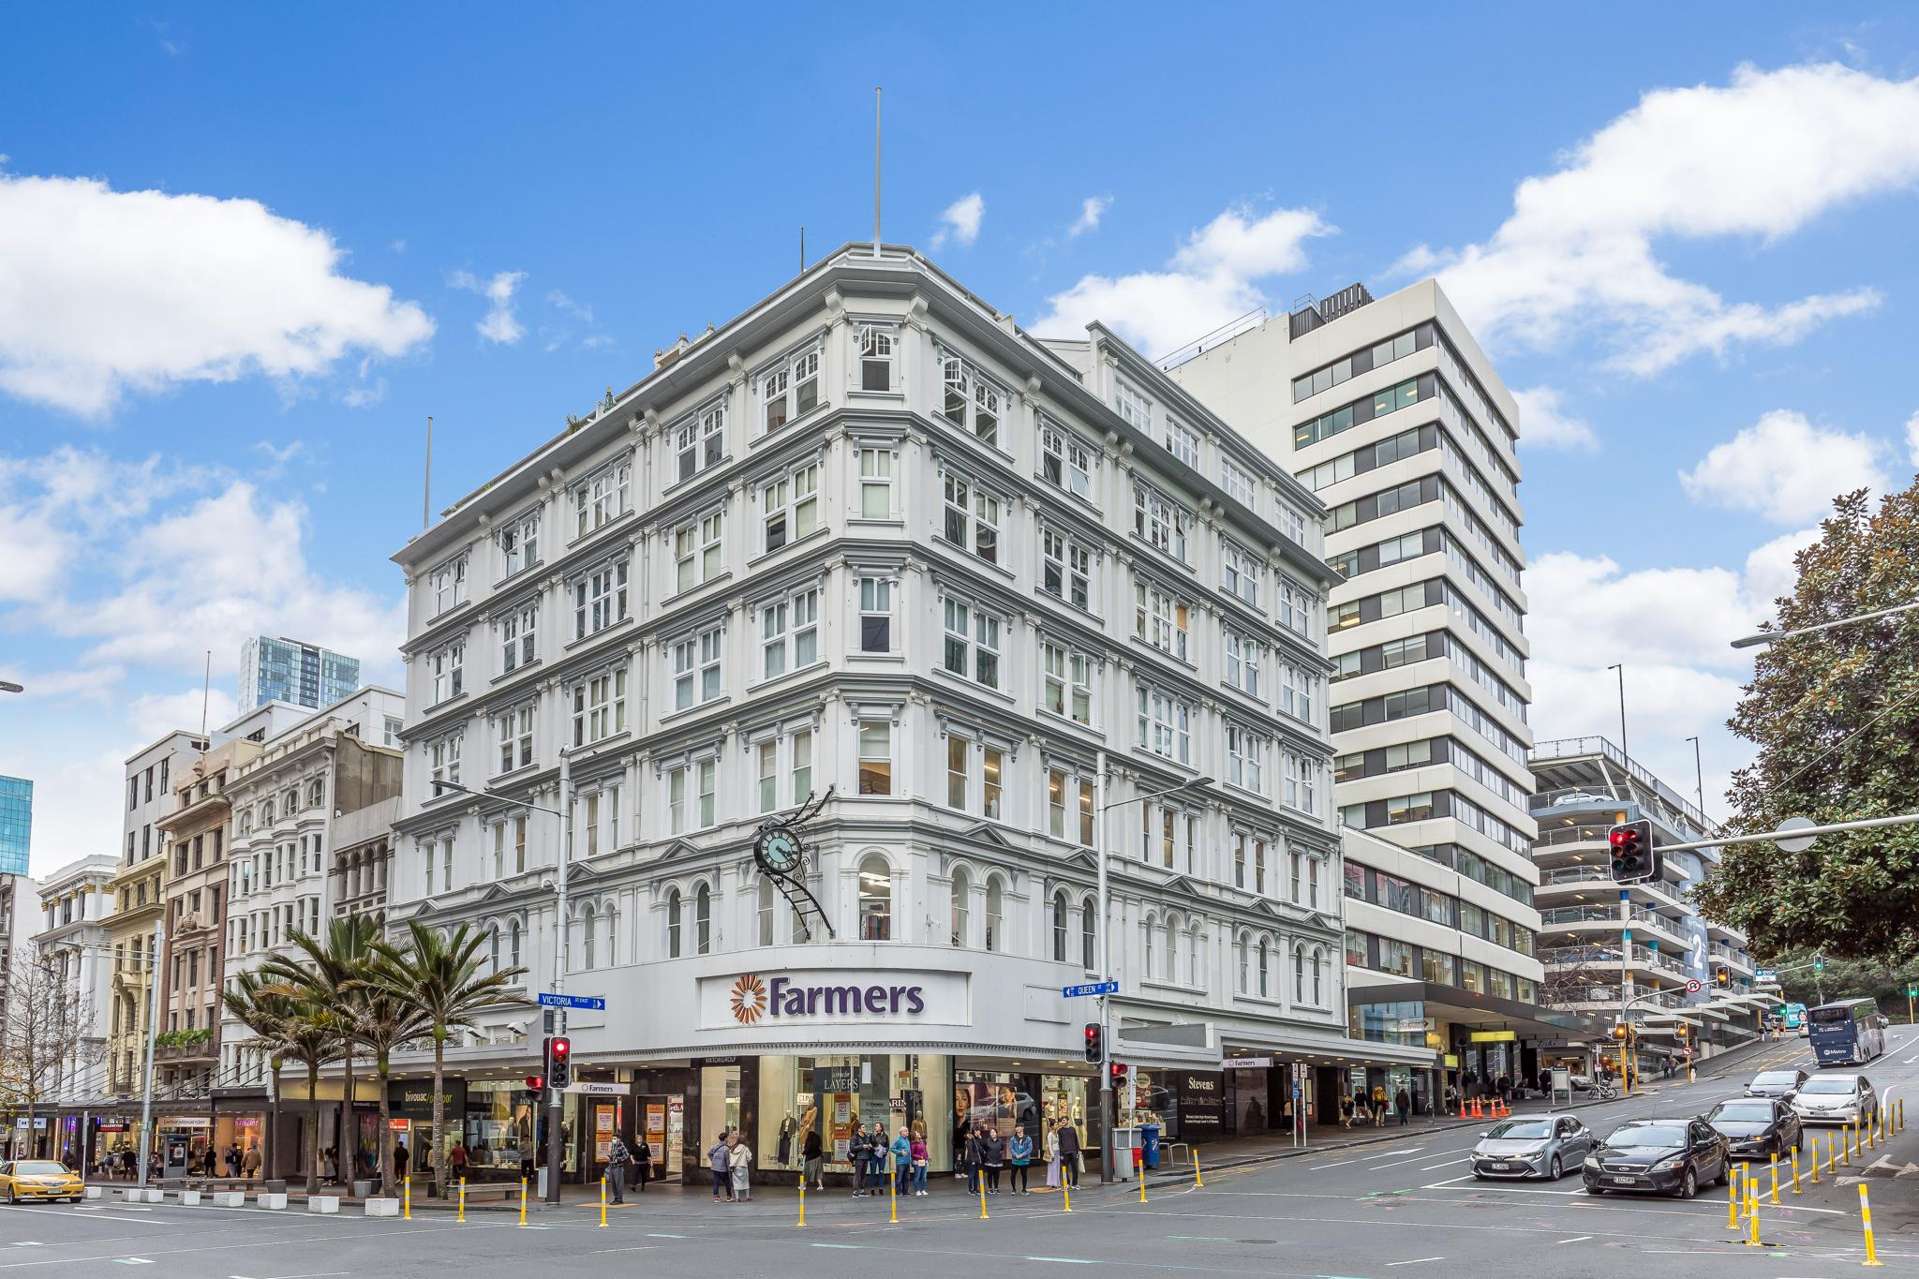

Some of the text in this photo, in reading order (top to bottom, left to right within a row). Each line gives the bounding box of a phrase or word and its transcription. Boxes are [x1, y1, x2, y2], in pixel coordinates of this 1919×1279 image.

[1077, 985, 1096, 995] QUEEN
[542, 995, 572, 1007] VICTORIA
[770, 976, 925, 1017] Farmers
[589, 1084, 614, 1093] Farmers
[824, 1079, 859, 1090] LAYERS
[1188, 1076, 1215, 1091] Stevens
